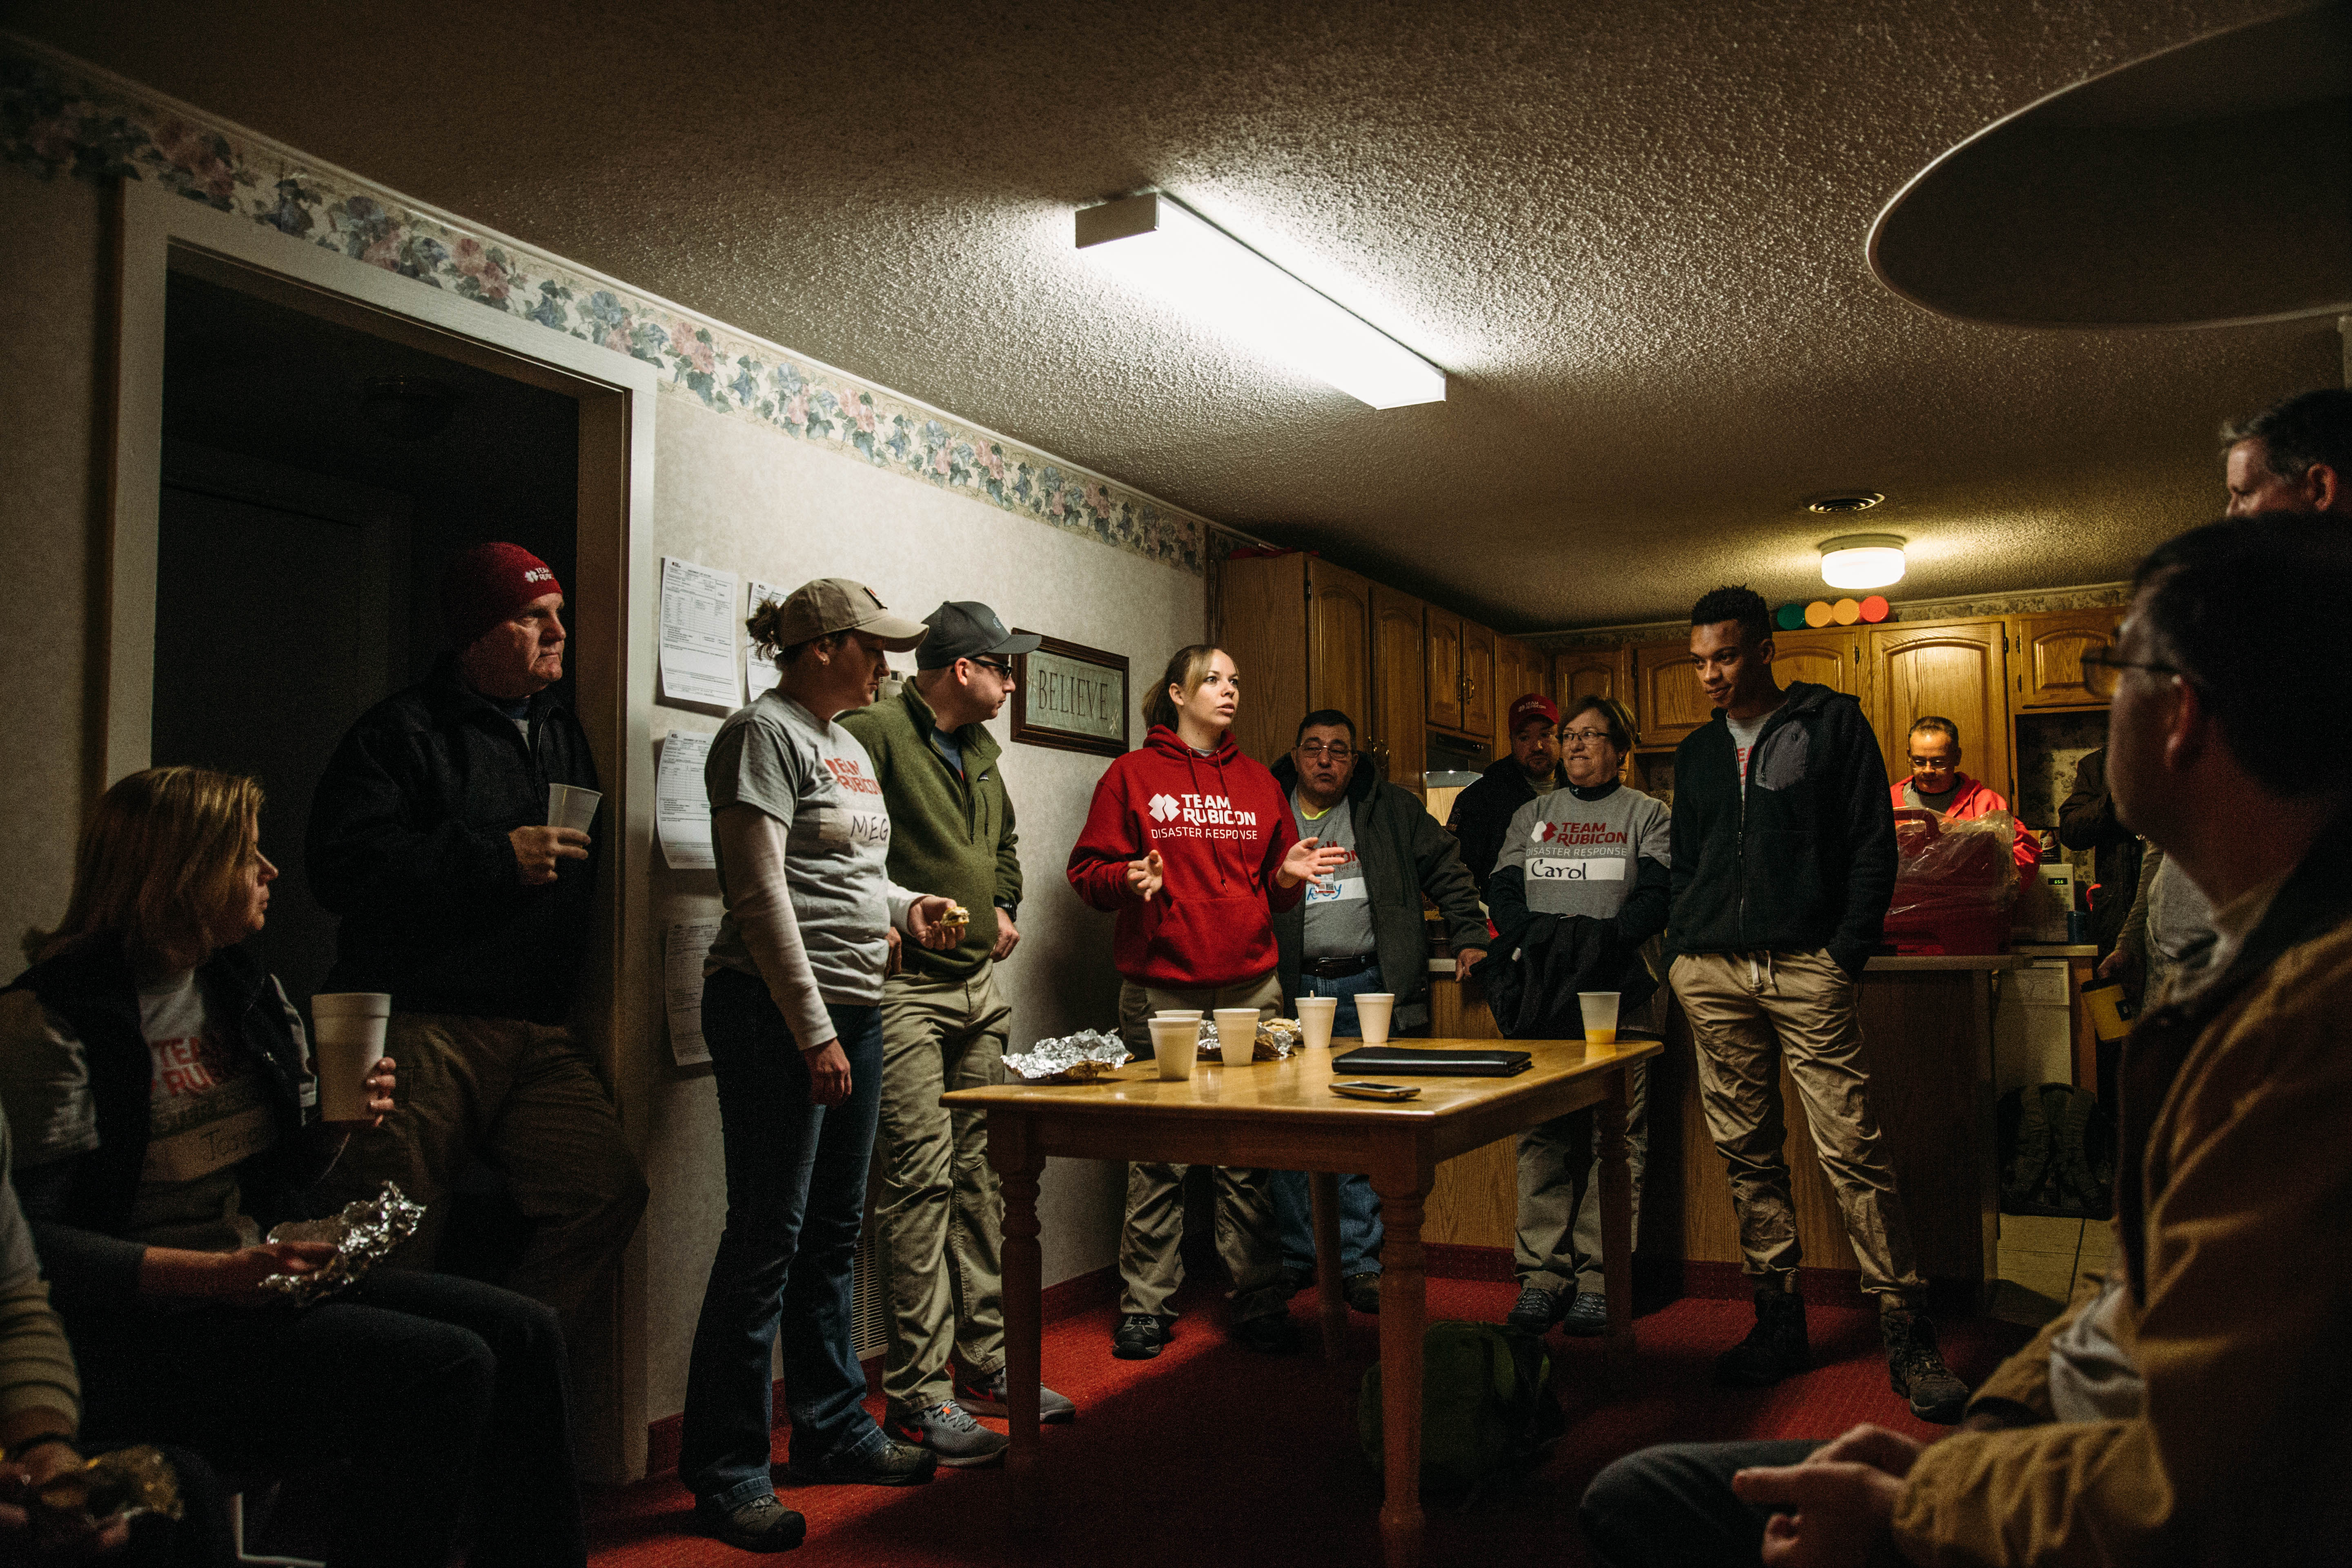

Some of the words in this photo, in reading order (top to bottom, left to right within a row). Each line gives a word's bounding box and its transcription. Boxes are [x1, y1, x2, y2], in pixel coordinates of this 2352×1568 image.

[1038, 670, 1108, 720] BELIEVE
[1181, 794, 1232, 810] TEAM
[1183, 808, 1256, 826] RUBICON
[851, 815, 888, 841] MEG
[1151, 826, 1202, 839] DISASTER
[1562, 822, 1606, 833] TEAM
[1556, 832, 1628, 847] RUBICON
[1526, 847, 1570, 857] DISASTER
[1574, 847, 1628, 856] RESPONSE
[1531, 859, 1586, 880] Carol
